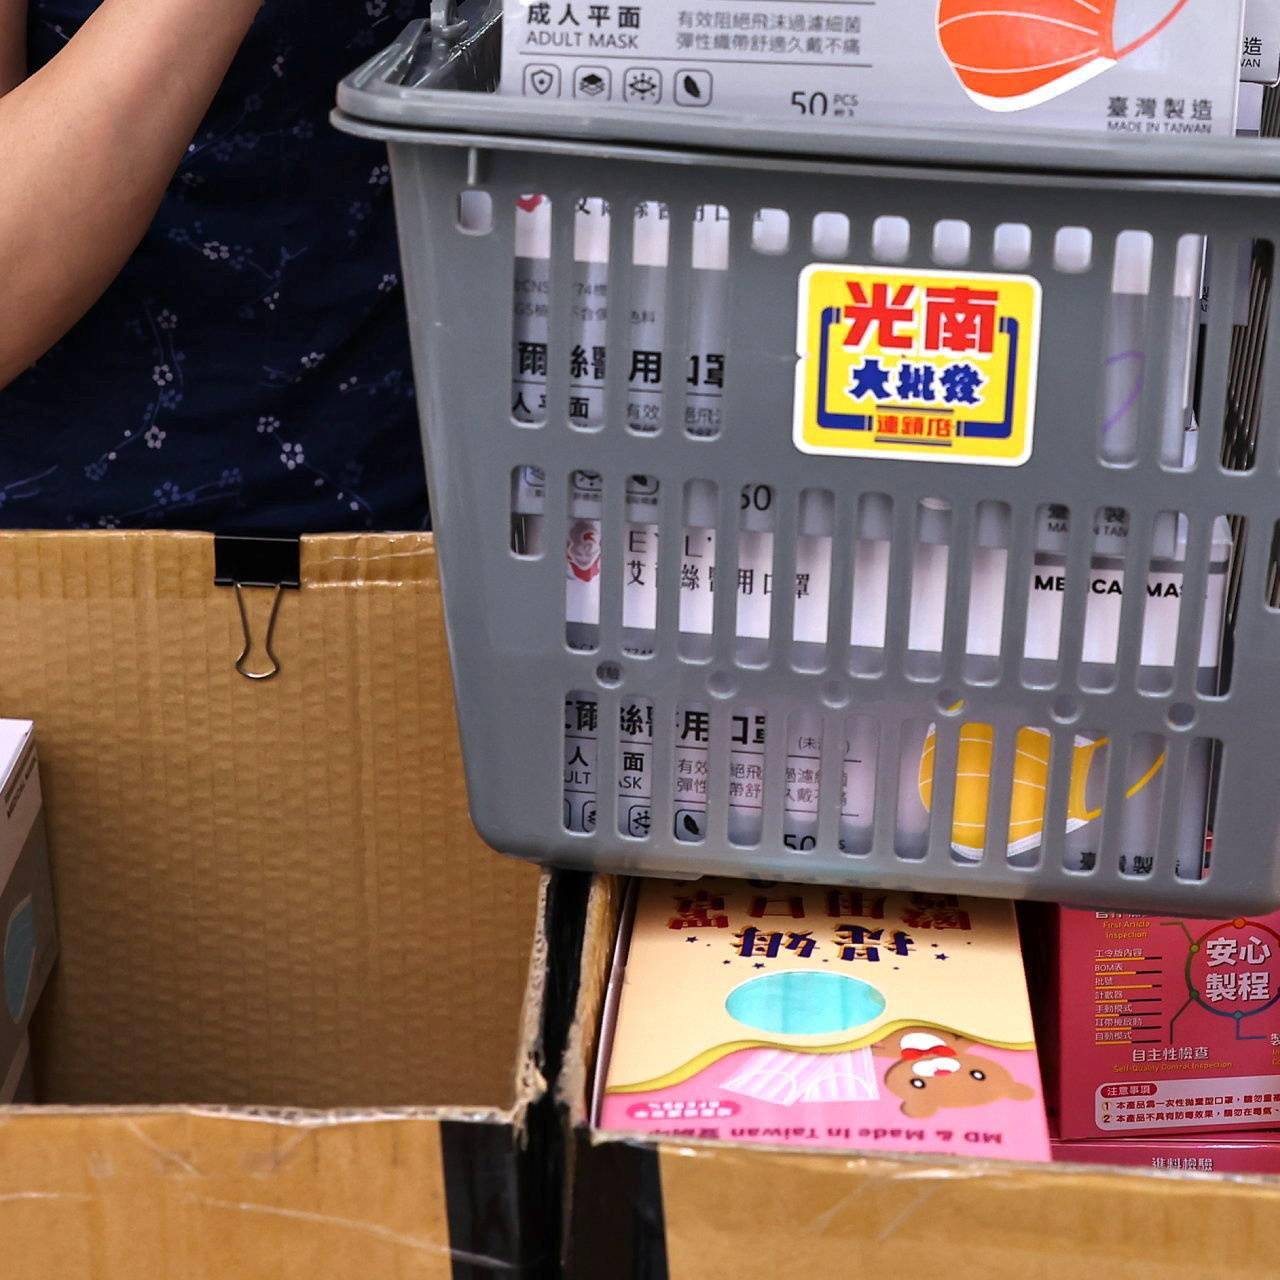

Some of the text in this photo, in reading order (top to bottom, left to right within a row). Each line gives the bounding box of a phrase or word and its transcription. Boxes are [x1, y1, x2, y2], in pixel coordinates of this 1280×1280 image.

[527, 1, 642, 30] 成人平面
[525, 30, 639, 50] ADULT MASK
[790, 90, 829, 117] 50
[842, 280, 1000, 354] 光南
[847, 358, 984, 405] 大批發
[876, 413, 953, 438] 連鎖店
[733, 923, 917, 963] 提姆
[1105, 930, 1149, 940] Inspection
[1206, 935, 1272, 968] 安心
[1205, 971, 1271, 1003] 製程
[1131, 1046, 1210, 1062] 自主性檢查
[1106, 1085, 1152, 1097] 注意事項
[730, 1126, 818, 1139] Taiwan
[827, 1127, 852, 1139] In
[859, 1127, 924, 1141] Made
[963, 1131, 1003, 1144] MD
